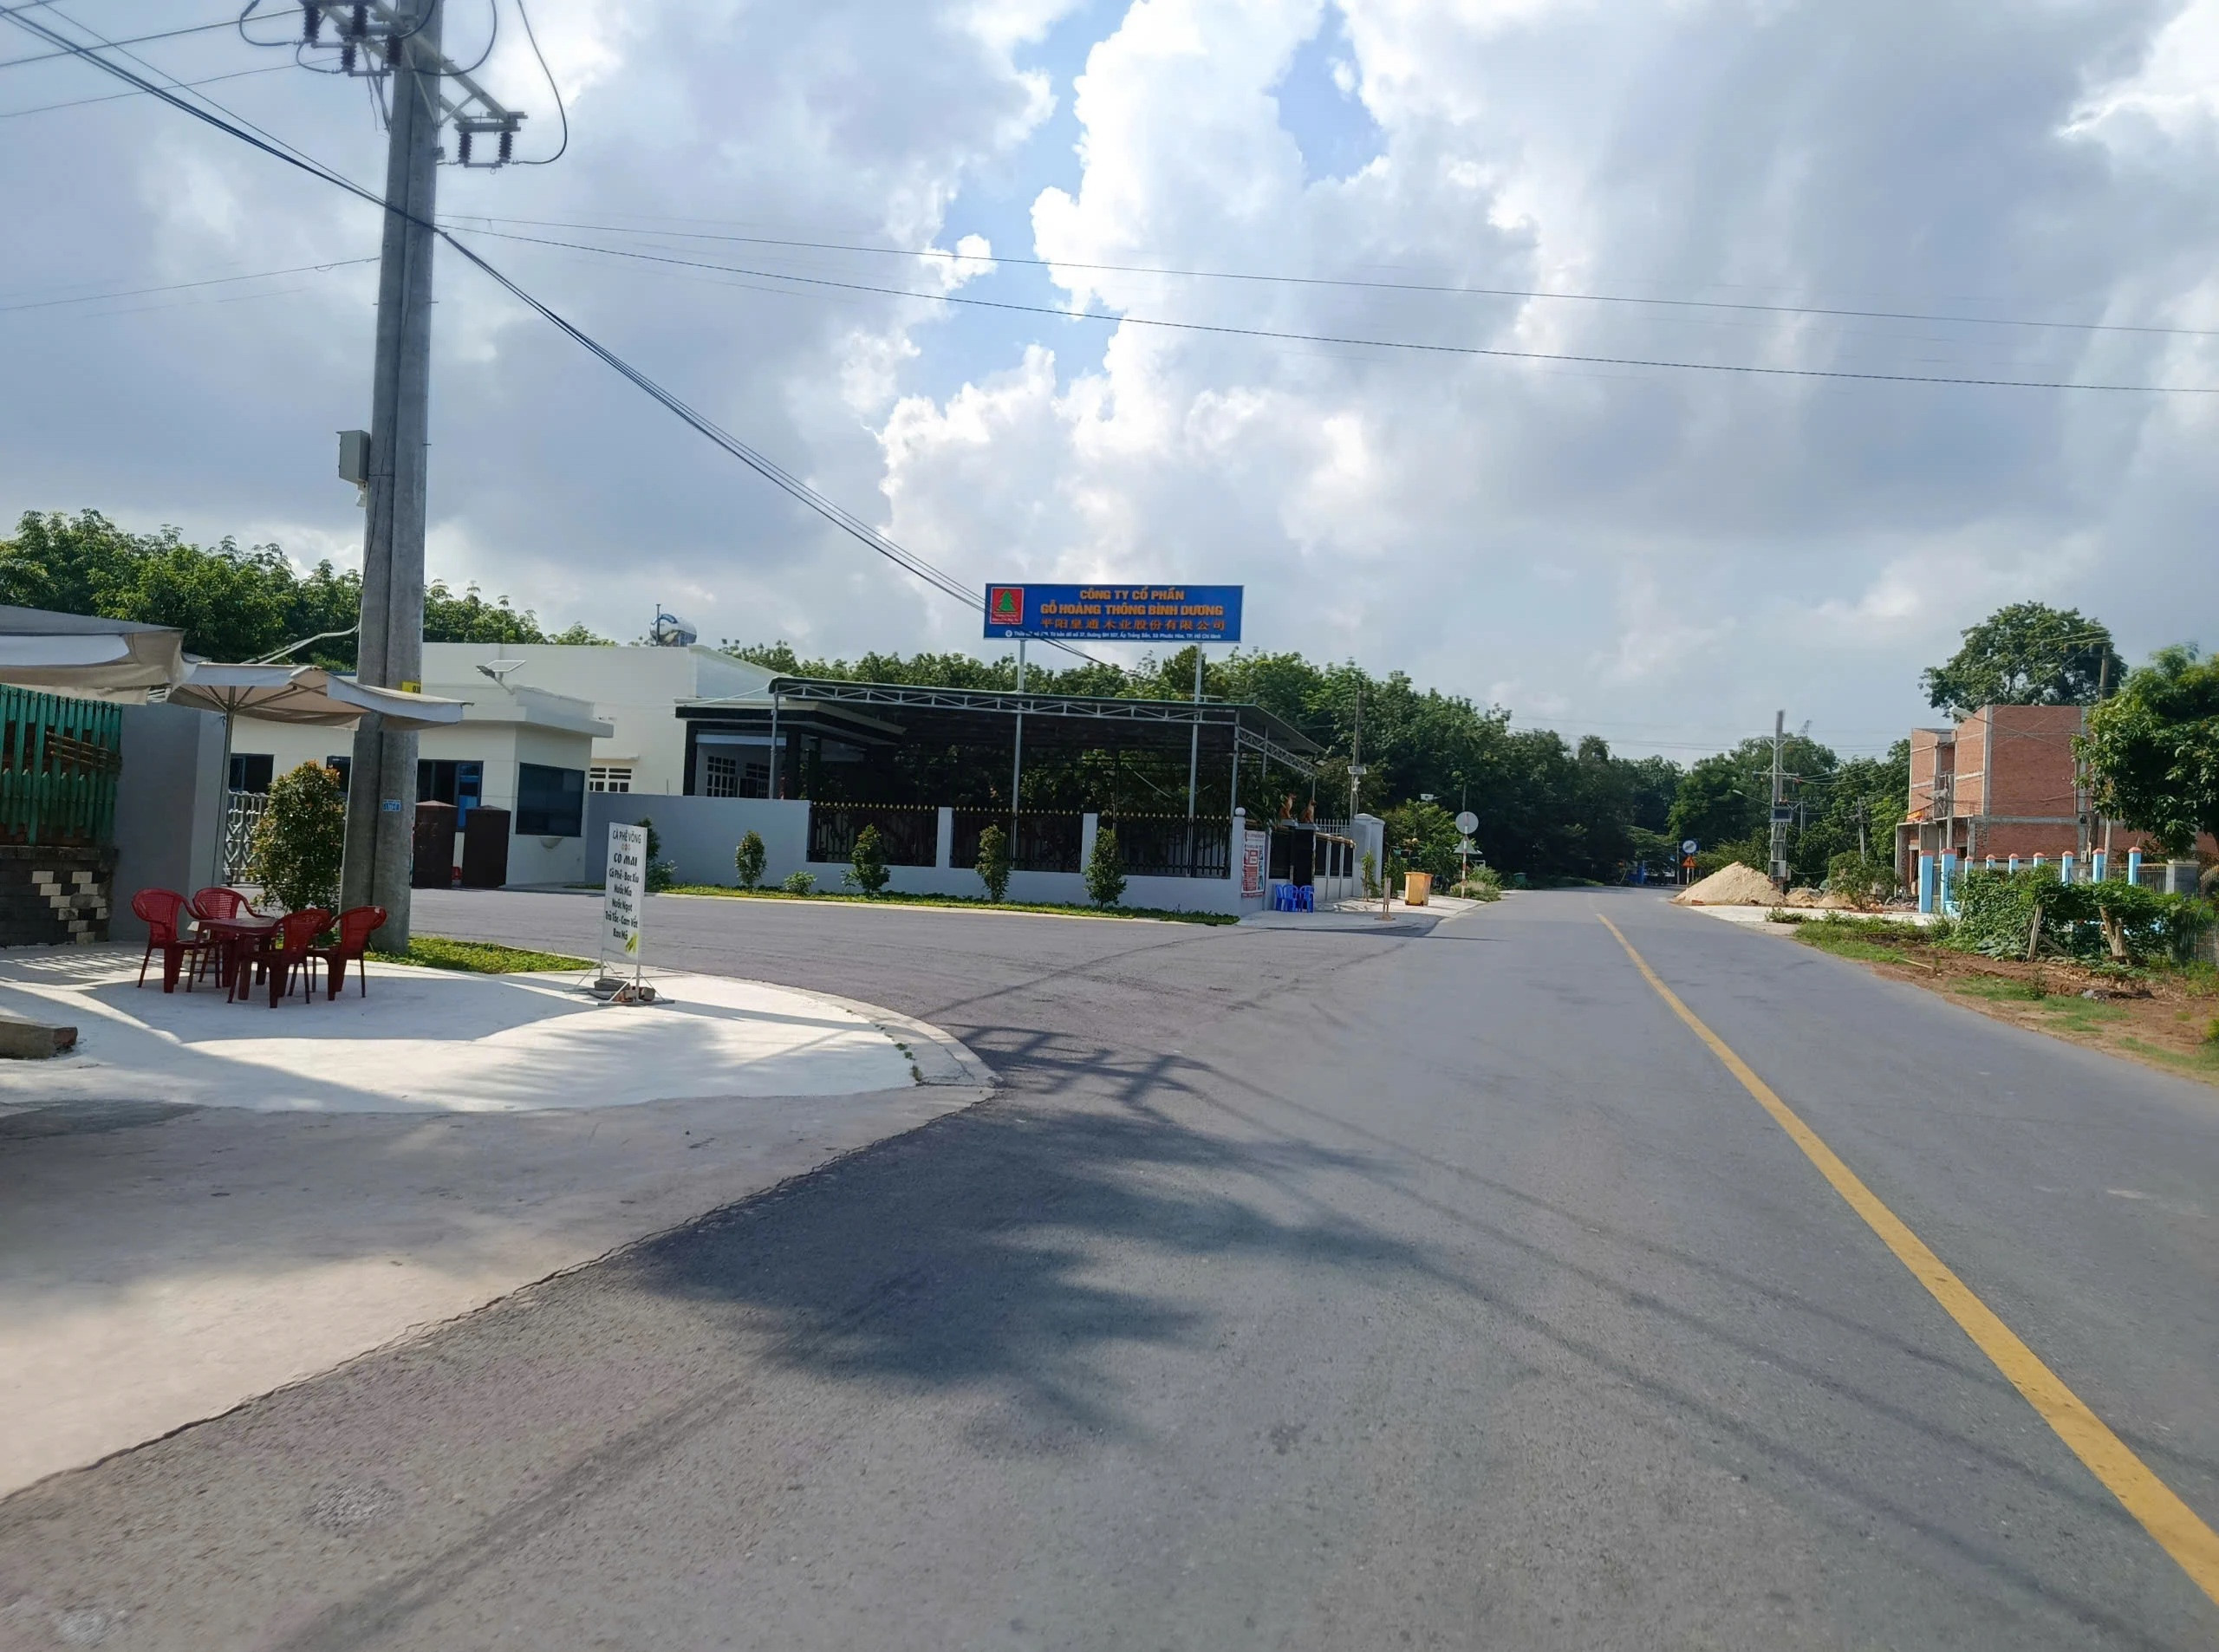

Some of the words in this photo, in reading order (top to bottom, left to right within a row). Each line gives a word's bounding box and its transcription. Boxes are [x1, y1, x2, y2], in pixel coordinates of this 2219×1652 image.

[1079, 589, 1111, 600] CÔNG
[1115, 589, 1129, 600] TY
[1132, 586, 1149, 600] CỔ
[1040, 600, 1057, 615] GỖ
[1058, 602, 1101, 615] HOÀNG
[1105, 602, 1146, 615] THÔNG
[1148, 602, 1178, 615] BÌNH
[1181, 604, 1223, 616] DƯƠNG
